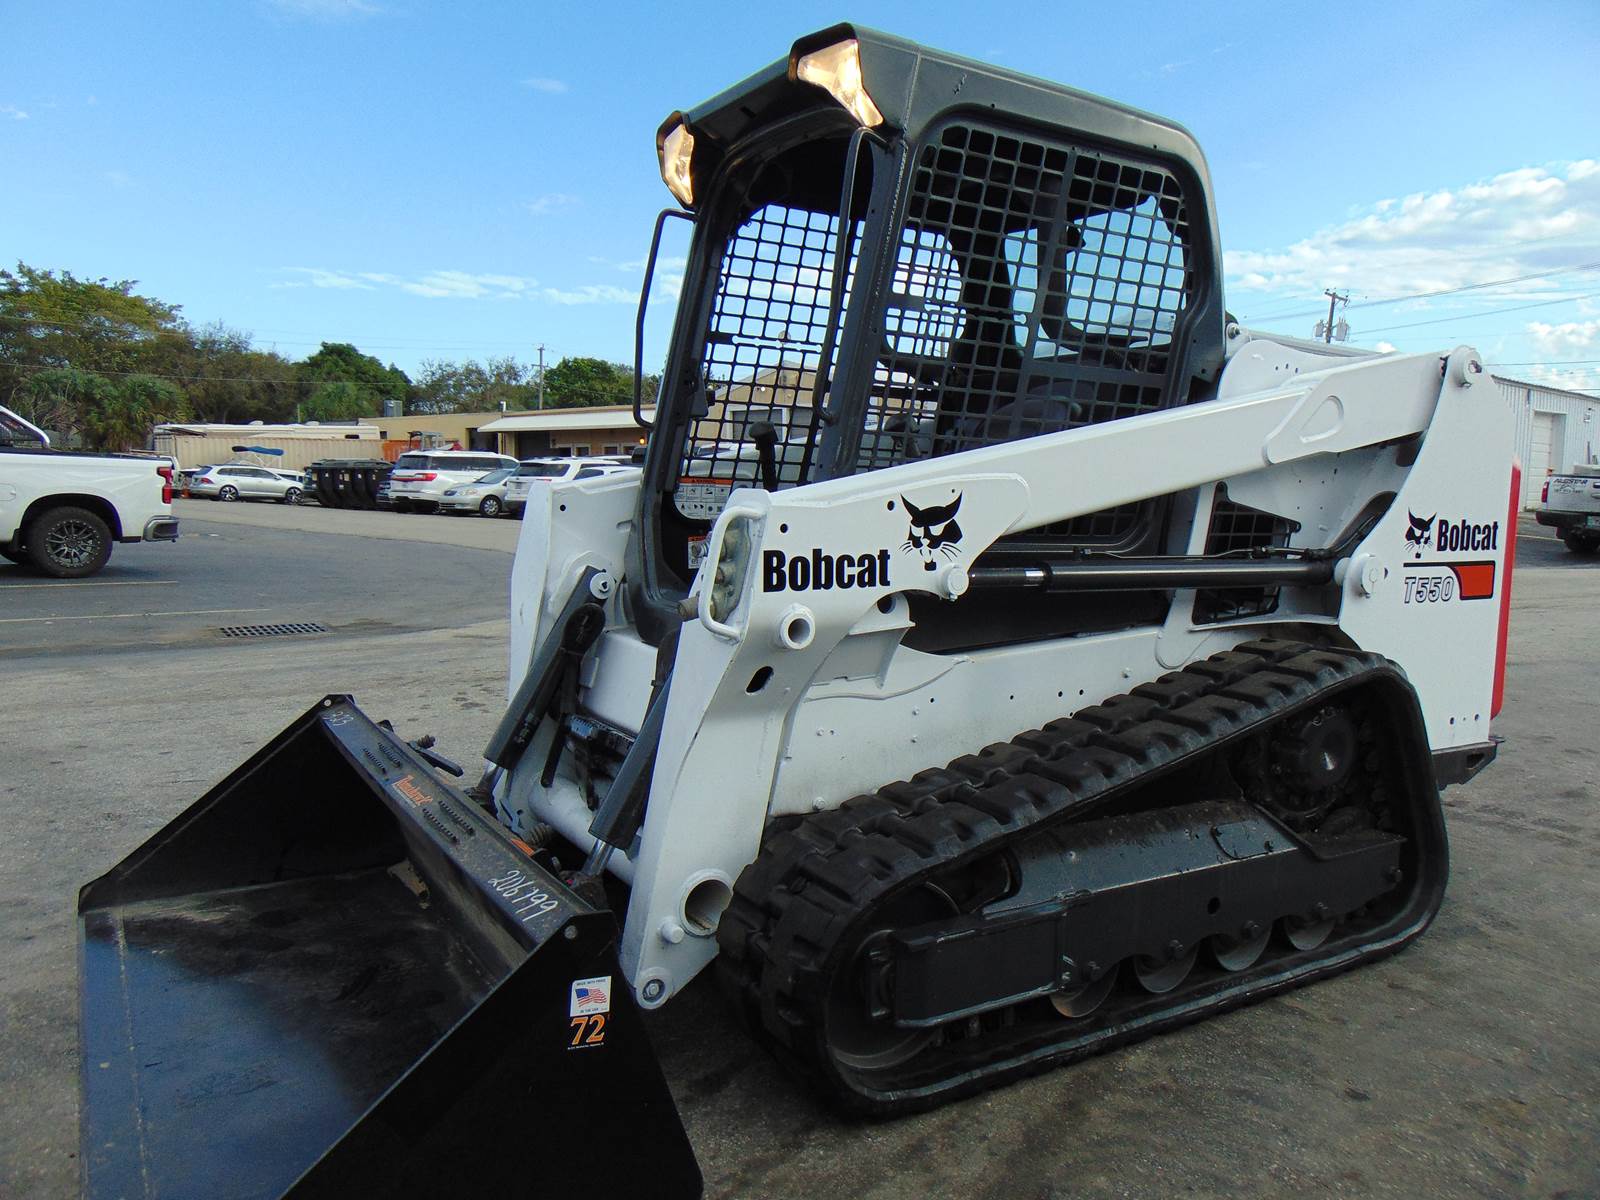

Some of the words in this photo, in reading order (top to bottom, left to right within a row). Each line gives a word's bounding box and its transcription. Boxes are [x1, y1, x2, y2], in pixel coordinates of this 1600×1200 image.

[1436, 519, 1498, 552] Bobcat
[763, 548, 891, 593] Bobcat
[1403, 576, 1454, 604] T550
[570, 1014, 606, 1046] 72
